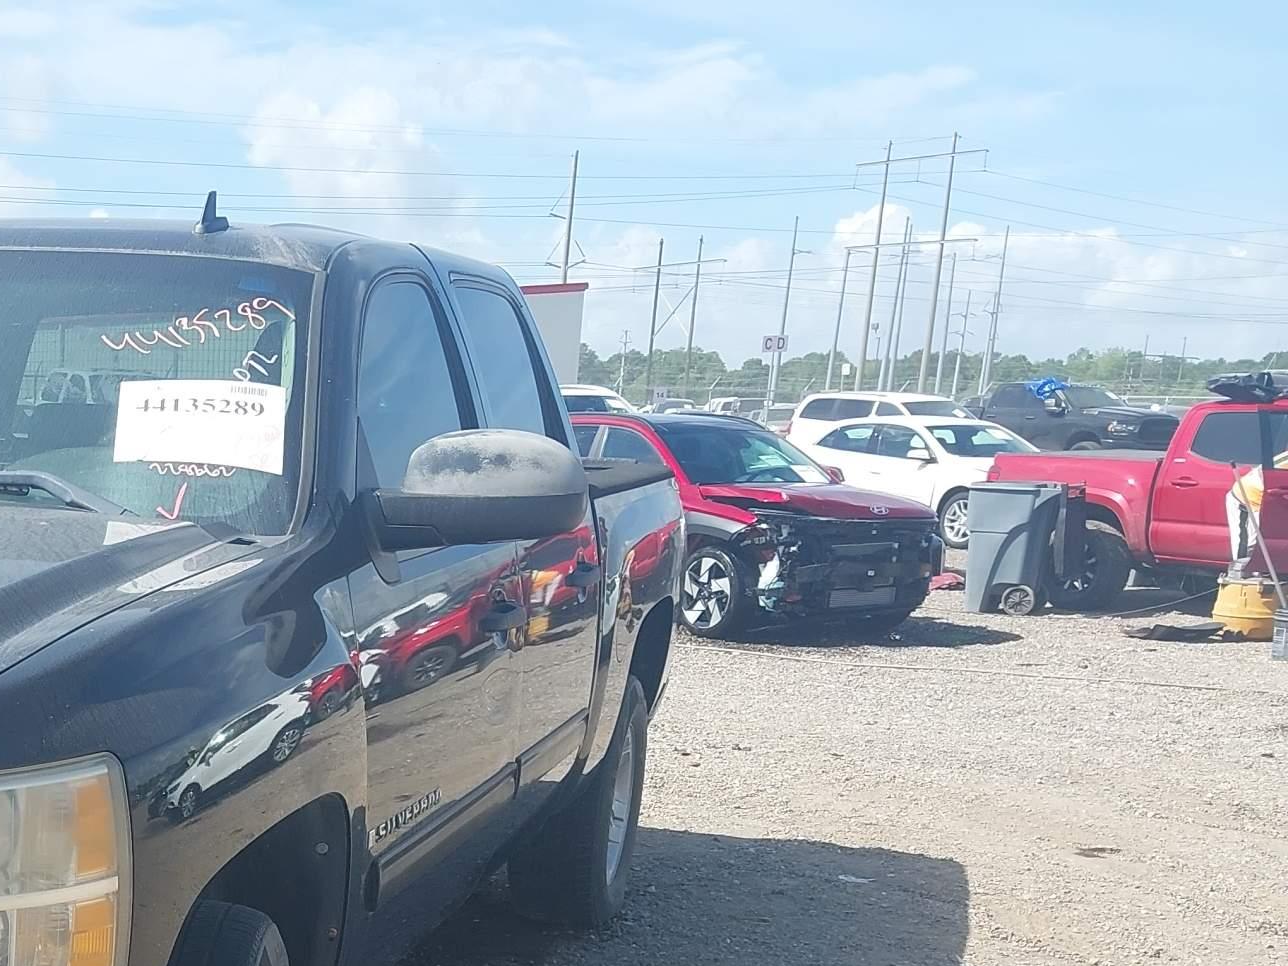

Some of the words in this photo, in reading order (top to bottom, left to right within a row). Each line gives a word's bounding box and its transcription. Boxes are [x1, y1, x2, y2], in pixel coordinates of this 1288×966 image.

[100, 298, 296, 354] 44135289
[765, 337, 773, 350] C
[777, 337, 785, 350] D
[136, 398, 265, 417] 44135289
